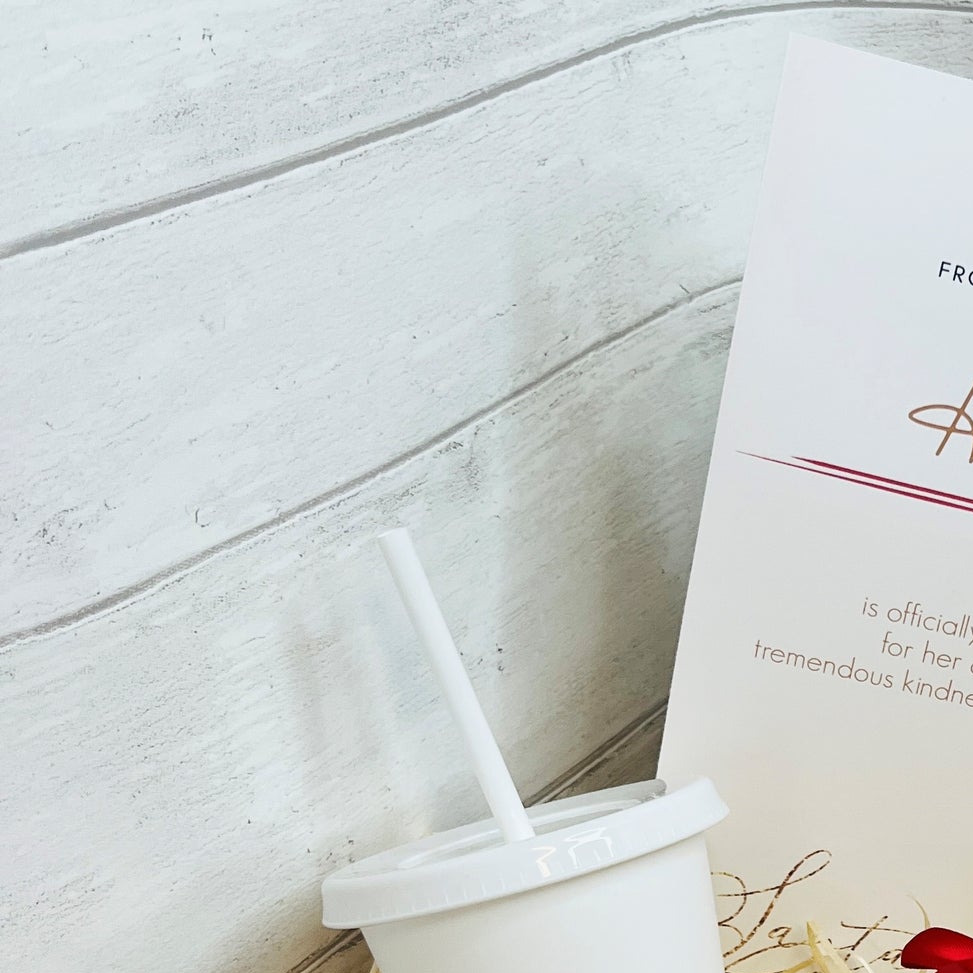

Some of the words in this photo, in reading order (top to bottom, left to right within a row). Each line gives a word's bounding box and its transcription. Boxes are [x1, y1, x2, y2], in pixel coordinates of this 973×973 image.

[863, 598, 878, 617] is
[755, 640, 893, 688] tremendous
[882, 631, 913, 658] for
[922, 640, 962, 669] her
